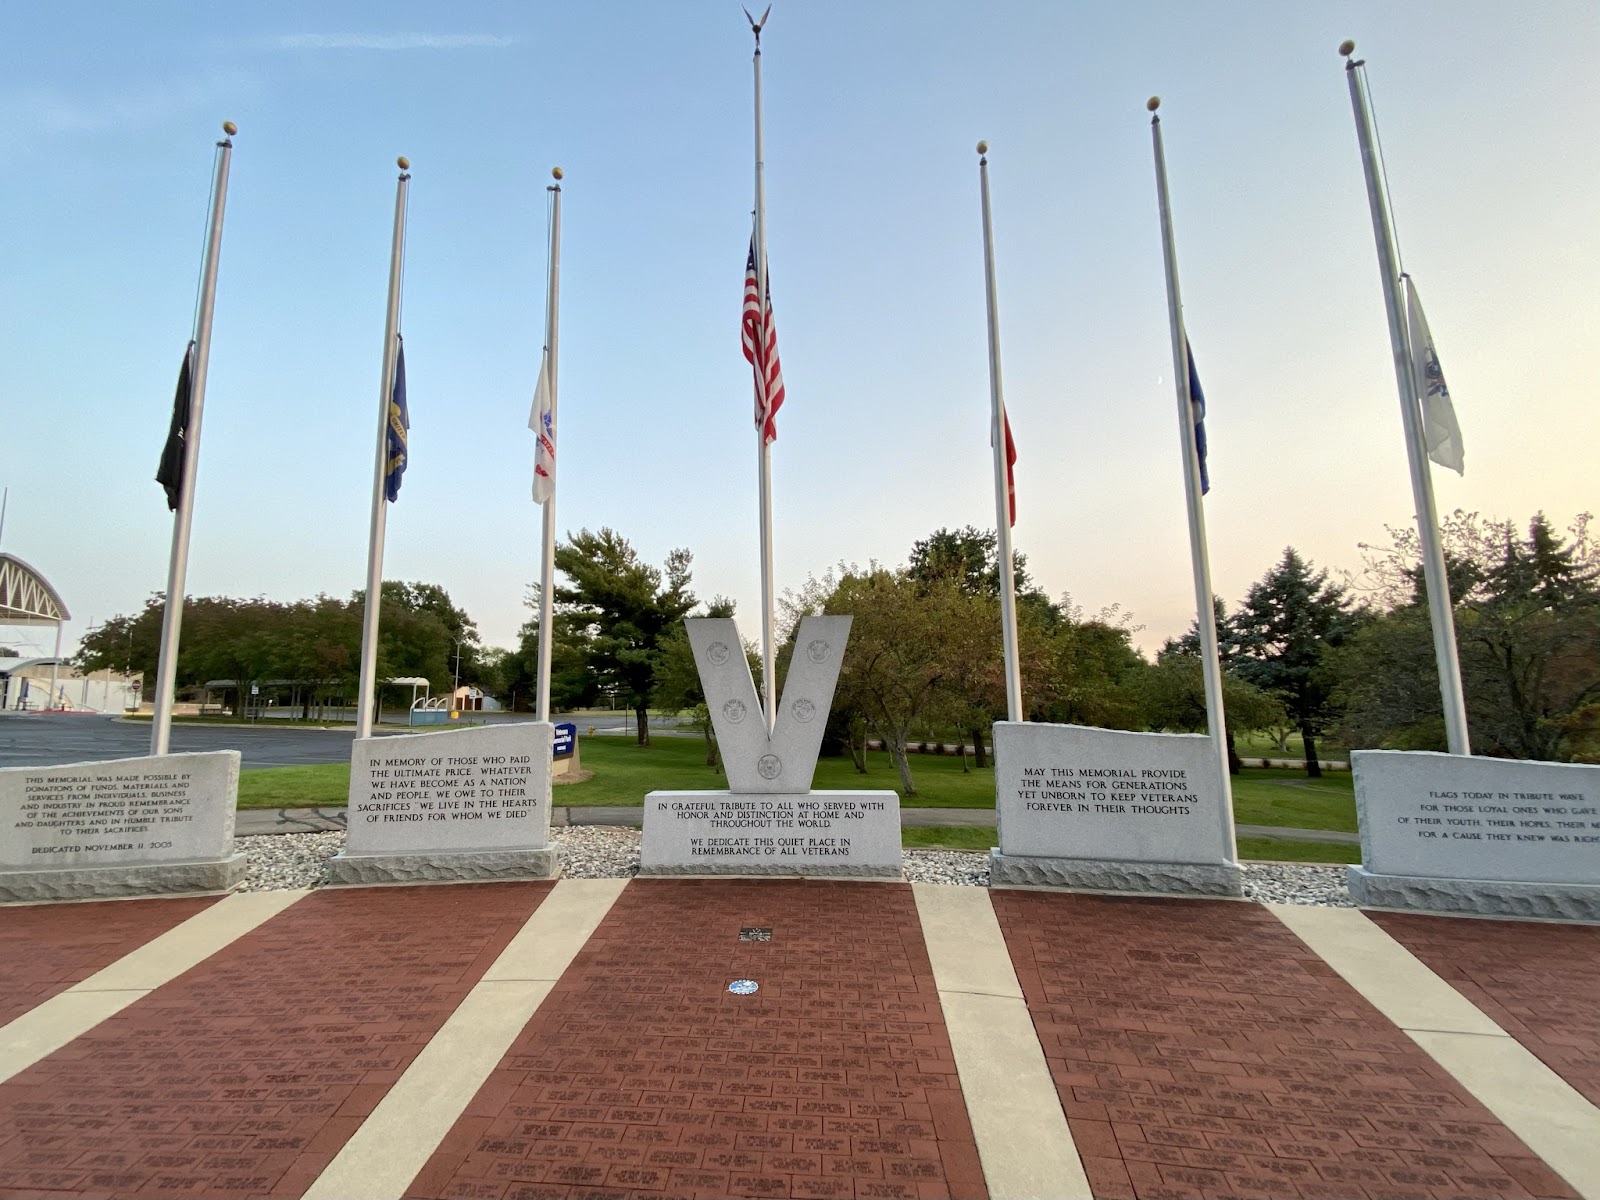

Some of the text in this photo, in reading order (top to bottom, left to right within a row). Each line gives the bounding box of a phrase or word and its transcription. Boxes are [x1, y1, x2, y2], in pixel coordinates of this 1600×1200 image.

[391, 417, 406, 439] UNITED
[448, 757, 477, 765] THOSE
[395, 769, 440, 777] ULTIMATE
[1079, 769, 1136, 777] MEMORIAL
[1142, 770, 1186, 778] PROVIDE
[1046, 780, 1081, 788] MEANS
[1112, 782, 1187, 790] GENERATIONS
[151, 790, 186, 798] BUSINESS
[370, 792, 392, 800] AND
[455, 790, 475, 798] OWE
[480, 789, 494, 797] TO
[1111, 793, 1135, 801] KEEP
[1141, 794, 1197, 802] VETERANS
[129, 799, 191, 807] REMEMBRANCE
[357, 803, 410, 811] SACRIFICES
[502, 799, 536, 807] HEARTS
[760, 802, 774, 810] TO
[798, 802, 819, 810] WHO
[1027, 803, 1073, 811] FOREVER
[1078, 804, 1089, 812] IN
[1131, 806, 1189, 814] THOUGHTS
[61, 809, 125, 818] ACHIEVEMENTS
[676, 811, 709, 819] HONOR
[713, 811, 733, 819] AND
[737, 811, 793, 819] DISTINCTION
[798, 811, 809, 819] AT
[813, 811, 839, 819] HOME
[384, 814, 423, 822] FRIENDS
[37, 819, 85, 827] DAUGHTERS
[708, 838, 749, 846] DEDICATE
[753, 838, 774, 846] THIS
[778, 838, 804, 848] QUIET
[809, 838, 835, 846] PLACE
[692, 847, 850, 855] REMEMBRANCE OF ALL VETERANS
